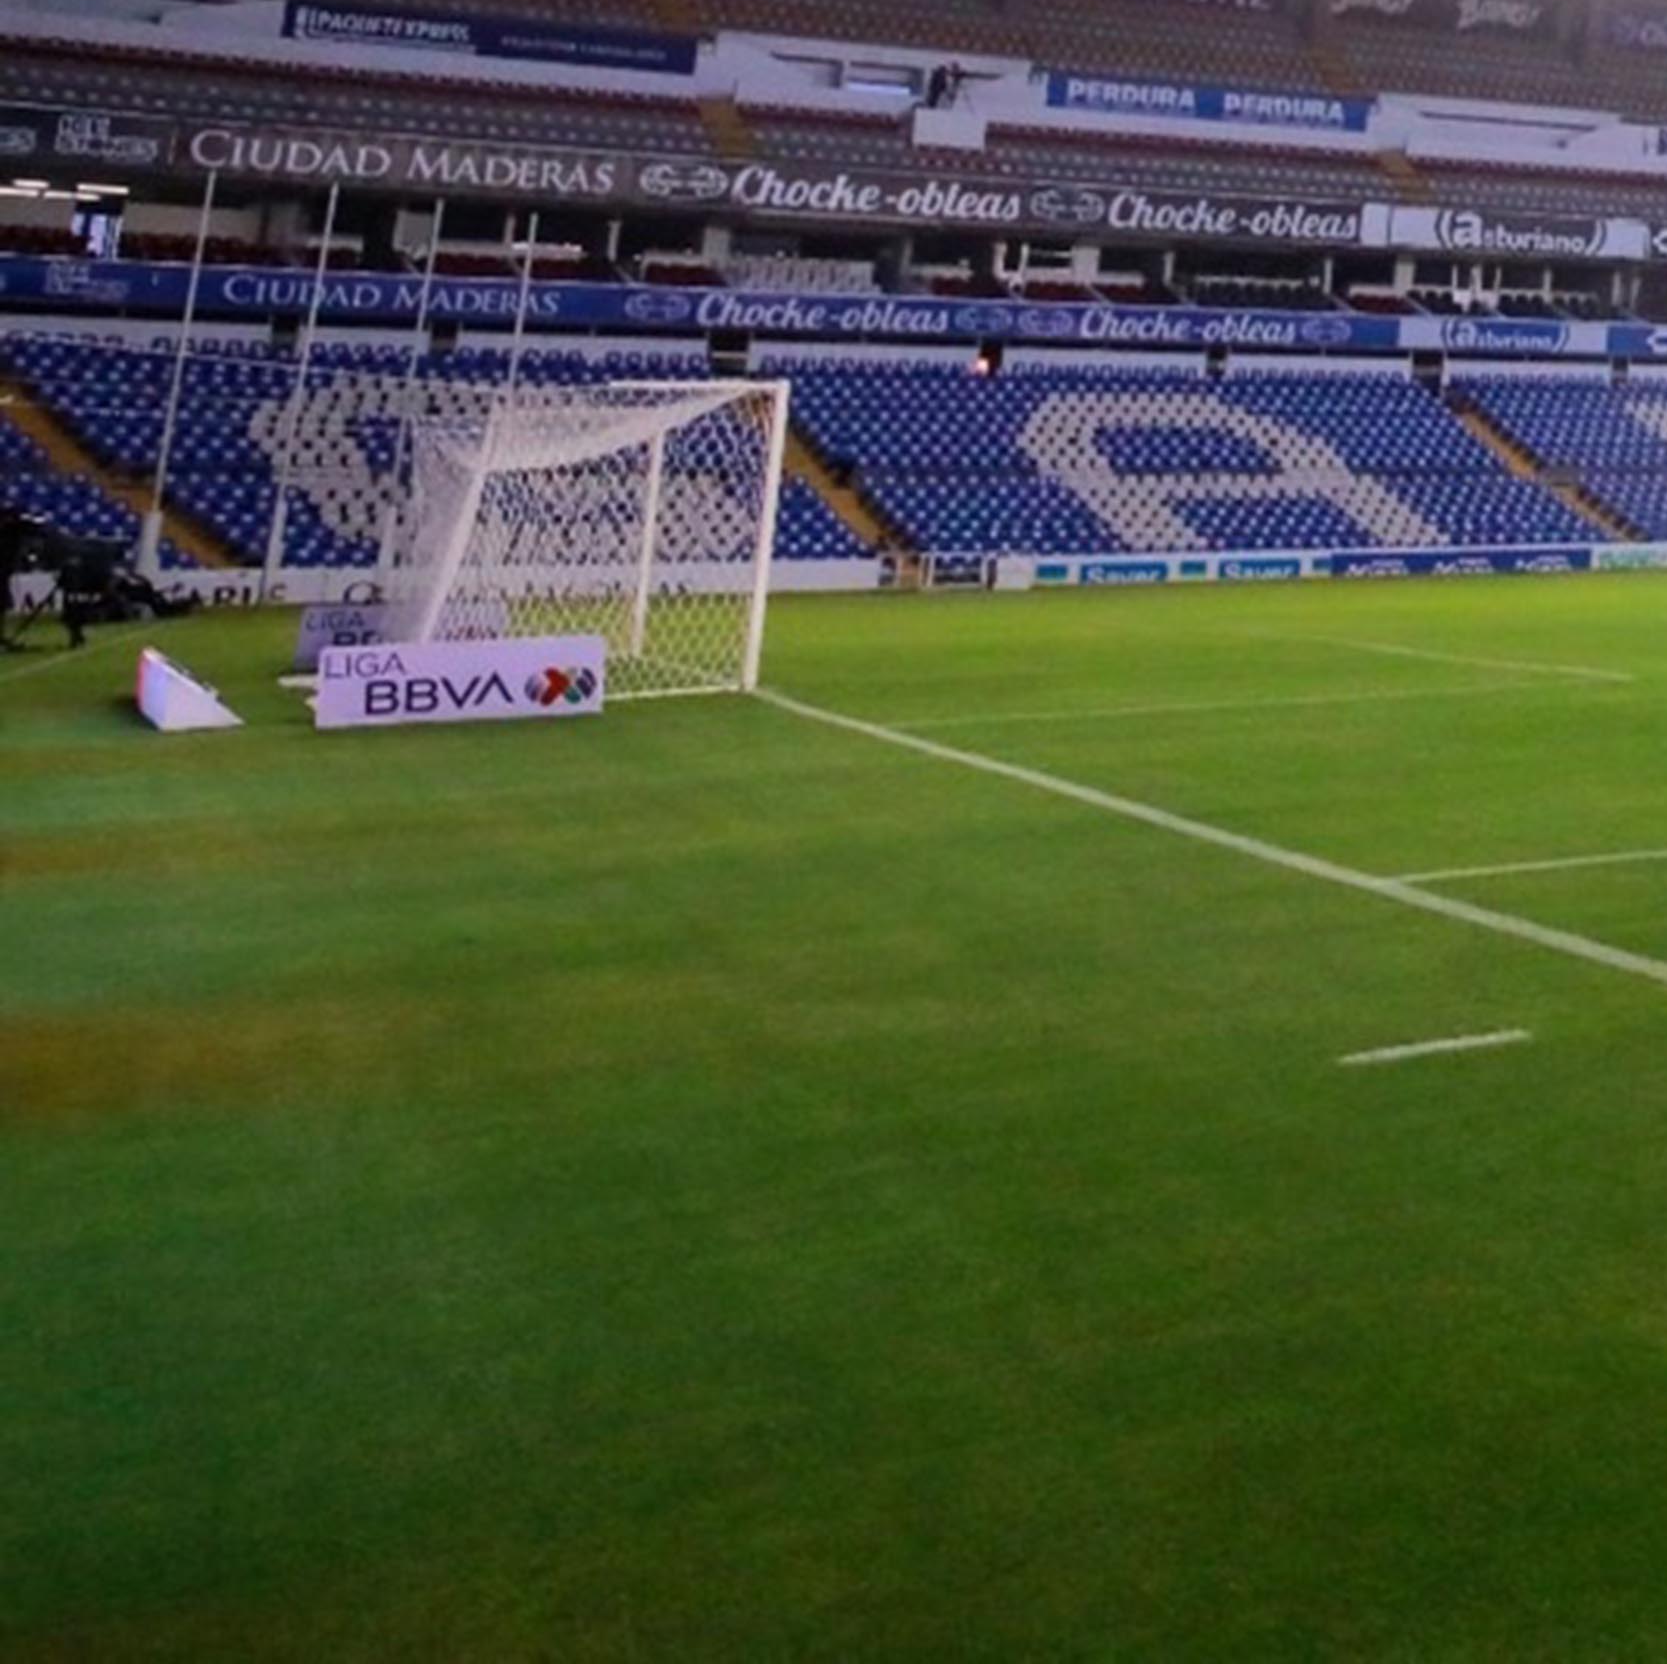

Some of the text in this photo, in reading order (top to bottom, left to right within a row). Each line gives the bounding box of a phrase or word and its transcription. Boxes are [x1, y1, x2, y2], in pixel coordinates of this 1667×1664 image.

[1067, 78, 1196, 113] PERDURA
[1223, 90, 1344, 124] PERDURA
[190, 129, 393, 178] CIUDAD
[406, 146, 617, 195] MADERAS
[731, 166, 1022, 222] Chocke-obleas
[1107, 193, 1360, 240] Chocke-obleas
[223, 274, 562, 319] CIUDAD MADERAS
[697, 290, 949, 335] Chocke-obleas
[1079, 310, 1297, 347] Chocke-obleas
[323, 651, 408, 681] LIGA
[364, 671, 516, 716] BBVA
